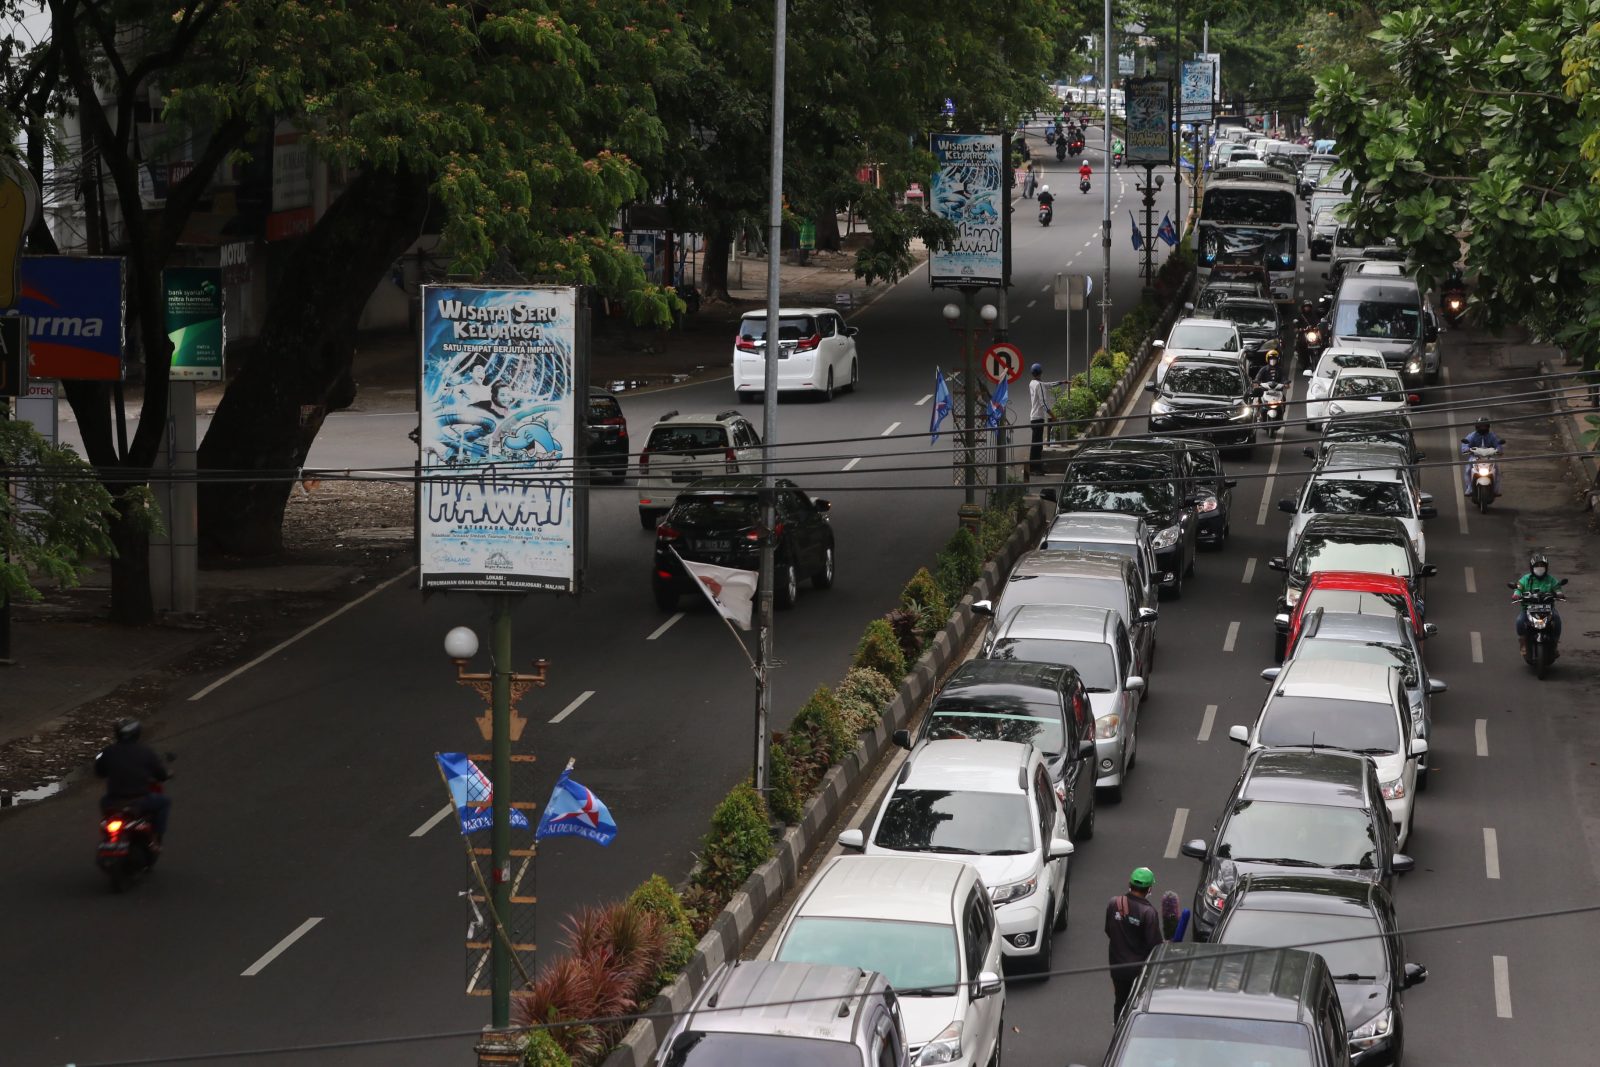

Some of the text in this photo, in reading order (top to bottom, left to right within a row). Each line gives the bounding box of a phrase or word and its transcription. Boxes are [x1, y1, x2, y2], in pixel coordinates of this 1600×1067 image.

[220, 242, 247, 266] MOTUL
[438, 299, 560, 323] WISATA SERU
[453, 321, 544, 340] KELUARGA
[443, 343, 555, 354] SATU TEMPAT BERJUTA IMPIAN
[27, 387, 53, 395] OTEK
[428, 464, 566, 526] HAWAI
[463, 817, 493, 831] PARTA
